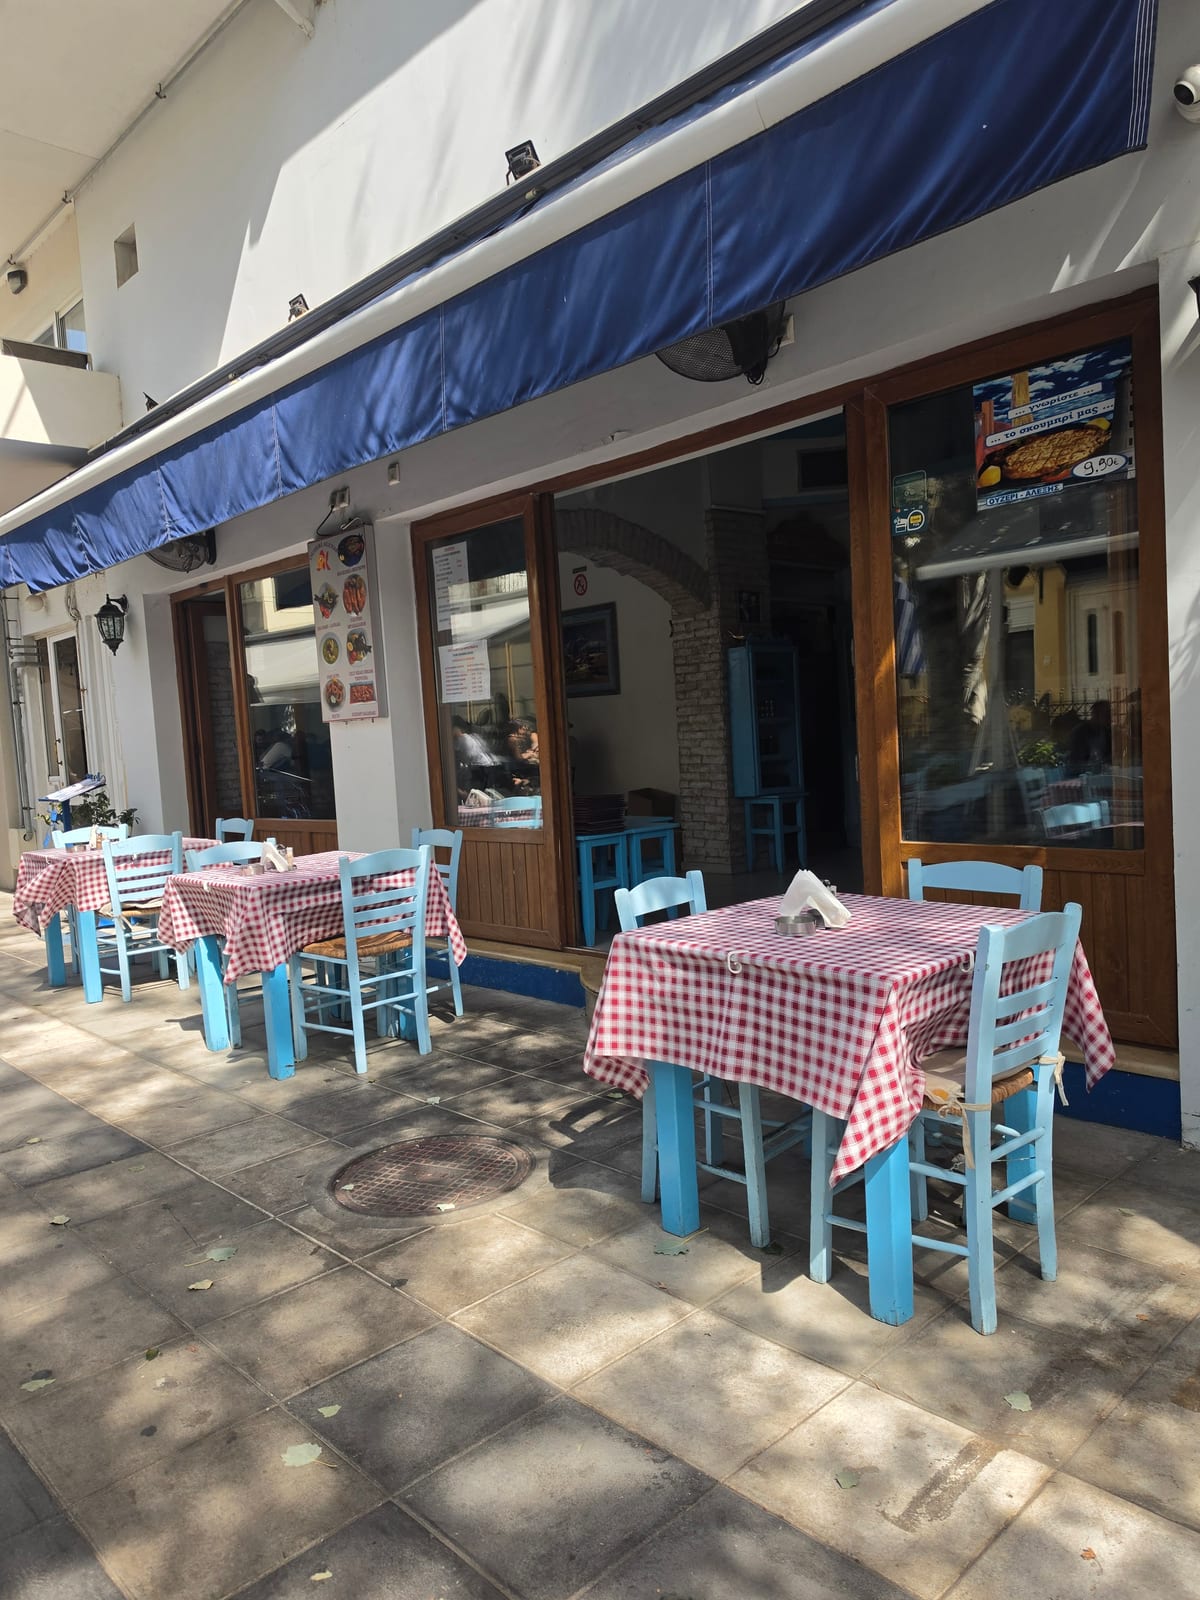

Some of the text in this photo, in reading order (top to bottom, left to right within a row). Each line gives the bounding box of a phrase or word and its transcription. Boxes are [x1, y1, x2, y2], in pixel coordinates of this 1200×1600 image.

[1028, 391, 1079, 412] γνωρίστε
[1004, 431, 1016, 439] το
[1019, 412, 1074, 434] σκουμπρί
[1077, 406, 1099, 418] μας
[989, 493, 1018, 505] ΟΥΖΕΡΙ
[1025, 485, 1060, 497] ΑΛΕΞΗΣ
